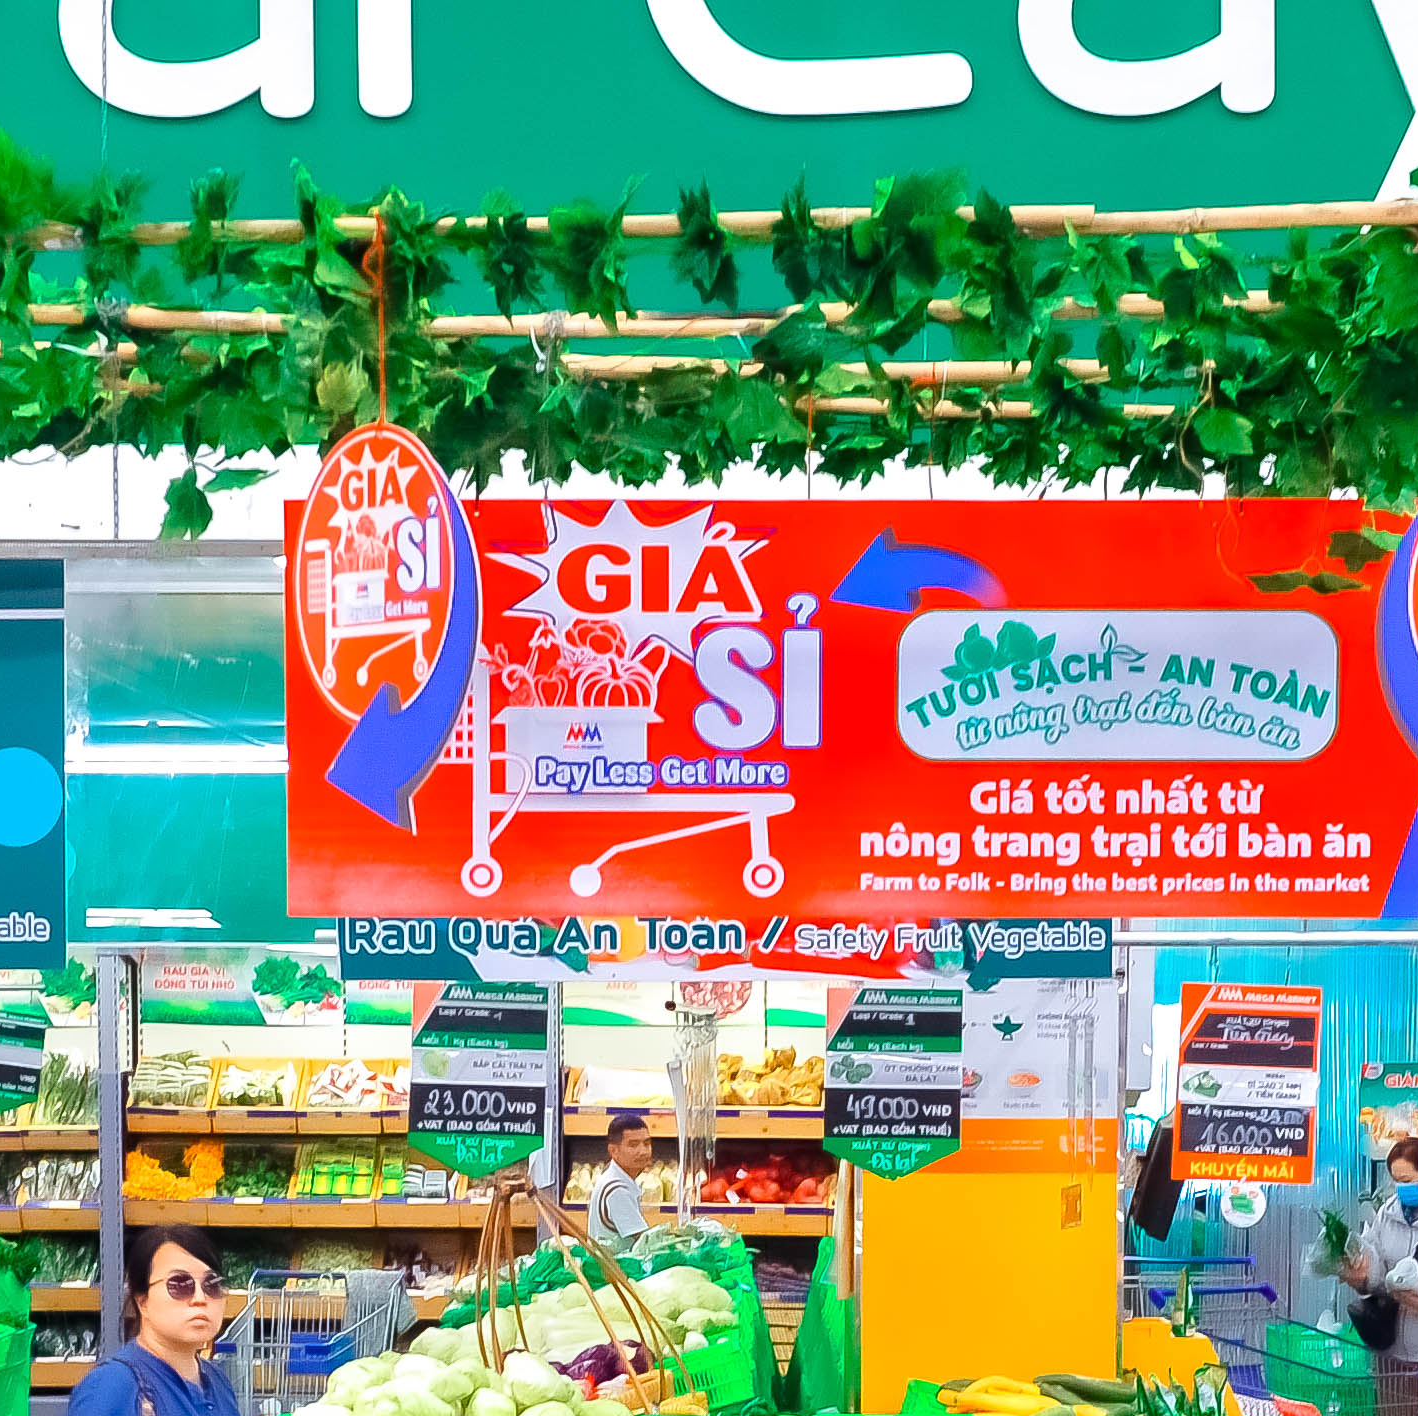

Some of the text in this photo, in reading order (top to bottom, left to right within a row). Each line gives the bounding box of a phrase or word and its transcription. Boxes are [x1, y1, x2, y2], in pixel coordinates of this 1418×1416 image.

[693, 592, 823, 750] SỈ
[1011, 652, 1114, 693] SẠCH
[1160, 655, 1214, 686] AN
[1230, 663, 1331, 719] TOÀN
[995, 702, 1067, 745] nông
[535, 756, 788, 794] Pay Less Get More
[970, 774, 1265, 815] Giá tốt nhất từ
[859, 822, 1372, 868] nông trang trại tới bàn ăn
[859, 872, 1370, 896] Farm to Folk Bring the best prices in the market
[344, 917, 436, 955] Rau
[555, 917, 619, 953] An
[794, 925, 886, 960] Safety
[895, 925, 963, 952] Fruit
[968, 925, 1107, 960] Vegetable
[424, 1088, 537, 1118] 23.000 VND
[847, 1094, 951, 1120] 49.000 VND
[1275, 1127, 1305, 1140] VND
